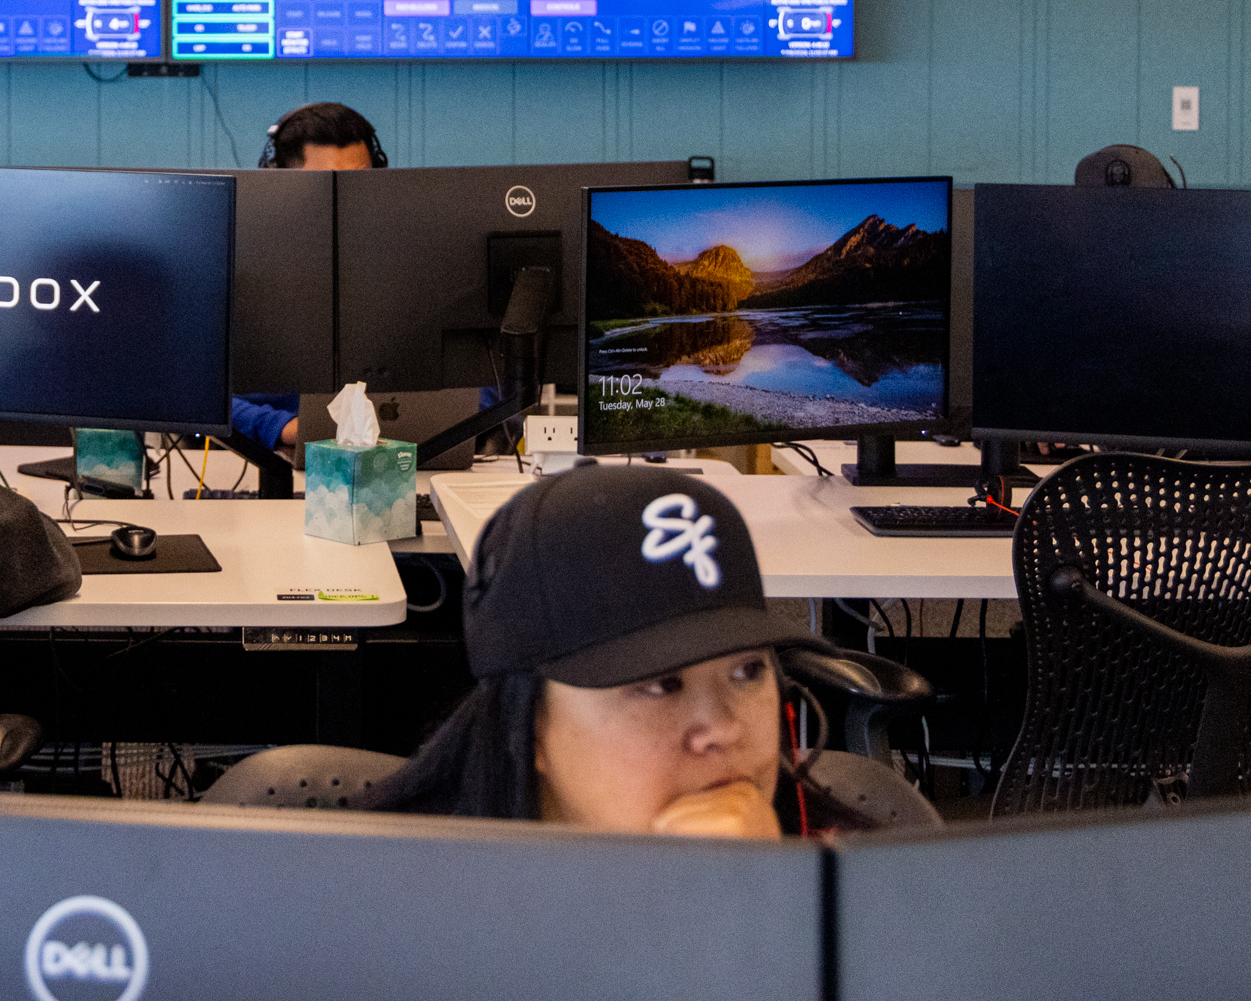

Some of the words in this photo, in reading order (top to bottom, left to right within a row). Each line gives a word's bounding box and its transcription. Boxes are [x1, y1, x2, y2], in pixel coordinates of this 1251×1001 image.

[509, 197, 533, 206] DELL
[598, 373, 643, 397] 11:02
[598, 400, 633, 412] Tuesday,
[635, 398, 654, 410] May
[654, 397, 666, 408] 28
[41, 939, 134, 981] DELL
